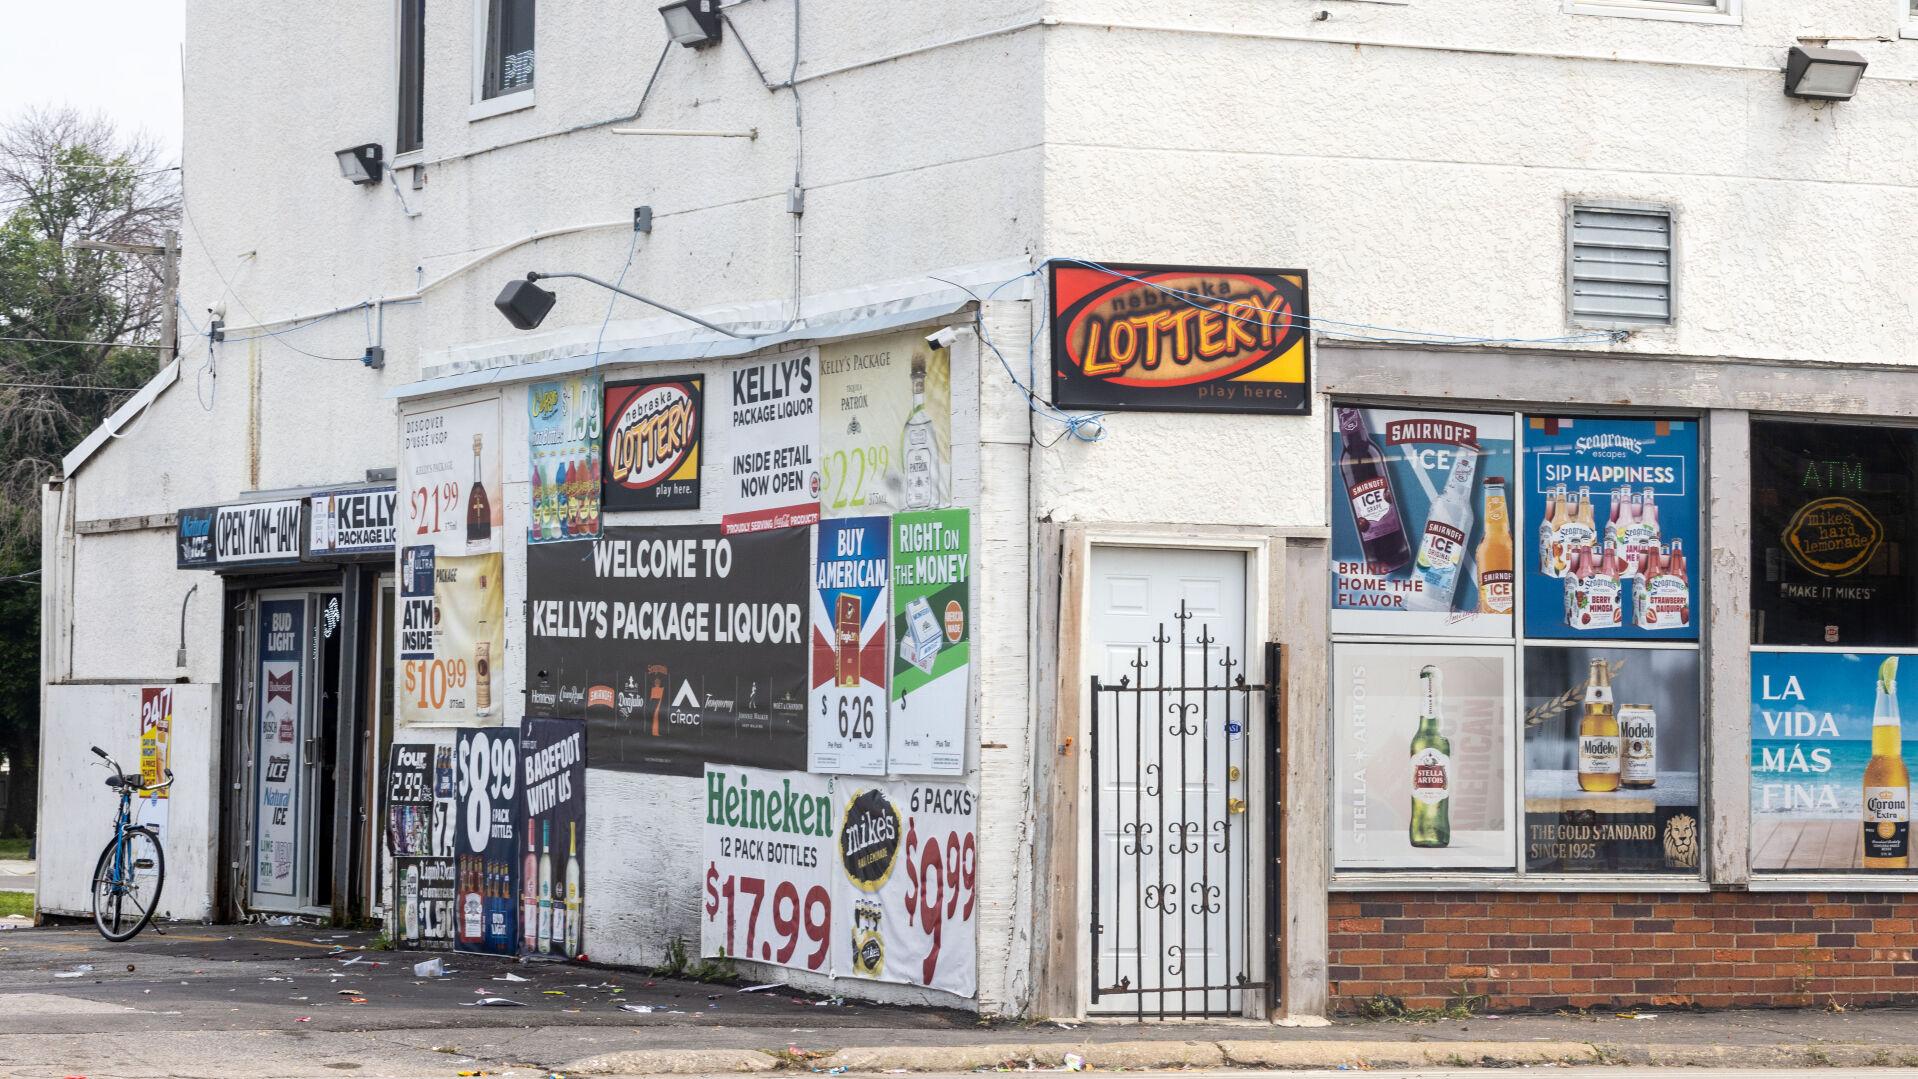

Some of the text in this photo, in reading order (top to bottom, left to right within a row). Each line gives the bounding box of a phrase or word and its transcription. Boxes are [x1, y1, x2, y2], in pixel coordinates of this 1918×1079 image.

[1112, 280, 1232, 312] nebraska
[1083, 295, 1284, 377] LOTTERY
[821, 352, 891, 376] KELLY'S PACKAGE
[733, 356, 813, 406] KELLY'S
[1198, 384, 1288, 399] play here.
[625, 389, 673, 421] nebraska
[733, 397, 813, 426] PACKAGE LIQUOR
[406, 416, 444, 434] DISCOVER
[1391, 422, 1471, 441] SMIRNOFF
[431, 431, 448, 445] VSOP
[613, 397, 693, 482] LOTTERY
[1575, 433, 1642, 455] Seagram's
[733, 444, 812, 475] INSIDE RETAIL
[1414, 449, 1450, 470] ICE
[1592, 450, 1627, 459] escapes
[1545, 464, 1675, 483] SIP HAPPINESS
[1803, 461, 1864, 489] ATM
[655, 482, 693, 497] play here.
[741, 474, 770, 499] NOW
[772, 470, 803, 493] OPEN
[1352, 479, 1384, 496] SMIRNOFF
[1362, 491, 1382, 507] ICE
[181, 514, 212, 537] Natural
[726, 513, 818, 534] PROUDLY SERVING PRODUCTS
[1808, 512, 1852, 525] mike's
[217, 511, 246, 557] OPEN
[249, 505, 299, 554] 7AM-1AM
[338, 529, 382, 546] PACKAGE
[900, 522, 960, 552] RIGHT ON
[1428, 523, 1463, 541] SMIRNOFF
[1819, 525, 1857, 539] hard
[191, 536, 208, 558] ICE
[837, 527, 865, 557] BUY
[1430, 536, 1454, 554] ICE
[1803, 535, 1868, 554] lemonade
[414, 558, 434, 570] ULTRA
[593, 538, 732, 578] WELCOME TO
[435, 568, 458, 583] PACKAGE
[817, 558, 886, 590] AMERICAN
[895, 553, 968, 586] THE MONEY
[1339, 562, 1389, 576] BRING
[1338, 578, 1423, 592] HOME THE
[1490, 584, 1510, 595] ICE
[1823, 586, 1833, 598] IT
[1337, 594, 1403, 607] FLAVOR
[1589, 604, 1613, 613] MIMOSA
[1592, 596, 1611, 604] BERRY
[1650, 596, 1686, 604] STRAWBERRY
[272, 613, 292, 632] BUD
[402, 600, 433, 630] ATM
[532, 600, 801, 644] KELLY'S PACKAGE LIQUOR
[268, 632, 295, 651] LIGHT
[402, 631, 433, 651] INSIDE
[1762, 675, 1805, 700] LA
[531, 689, 557, 707] Hennessy
[1621, 722, 1654, 738] Modelo
[1762, 712, 1840, 737] VIDA
[397, 747, 427, 767] four
[1353, 665, 1367, 846] STELLA ARTOIS
[1585, 741, 1615, 754] Modelo
[525, 732, 581, 786] BAREFOOT
[1762, 744, 1832, 773] MÁS
[268, 763, 288, 778] ICE
[1417, 769, 1443, 777] STELLA
[264, 786, 291, 806] Natural
[526, 770, 572, 817] WITH US
[910, 787, 971, 816] 6 PACKS
[1762, 783, 1840, 809] FINA
[706, 771, 834, 837] Heineken
[1868, 797, 1906, 813] Corona
[1876, 809, 1898, 819] Extra
[272, 807, 289, 825] ICE
[846, 808, 895, 856] mike's
[1530, 824, 1656, 840] THE GOLD STANDARD
[720, 836, 818, 868] 12 PACK BOTTLES
[1531, 844, 1596, 859] SINCE 1925
[705, 861, 832, 970] $17.99
